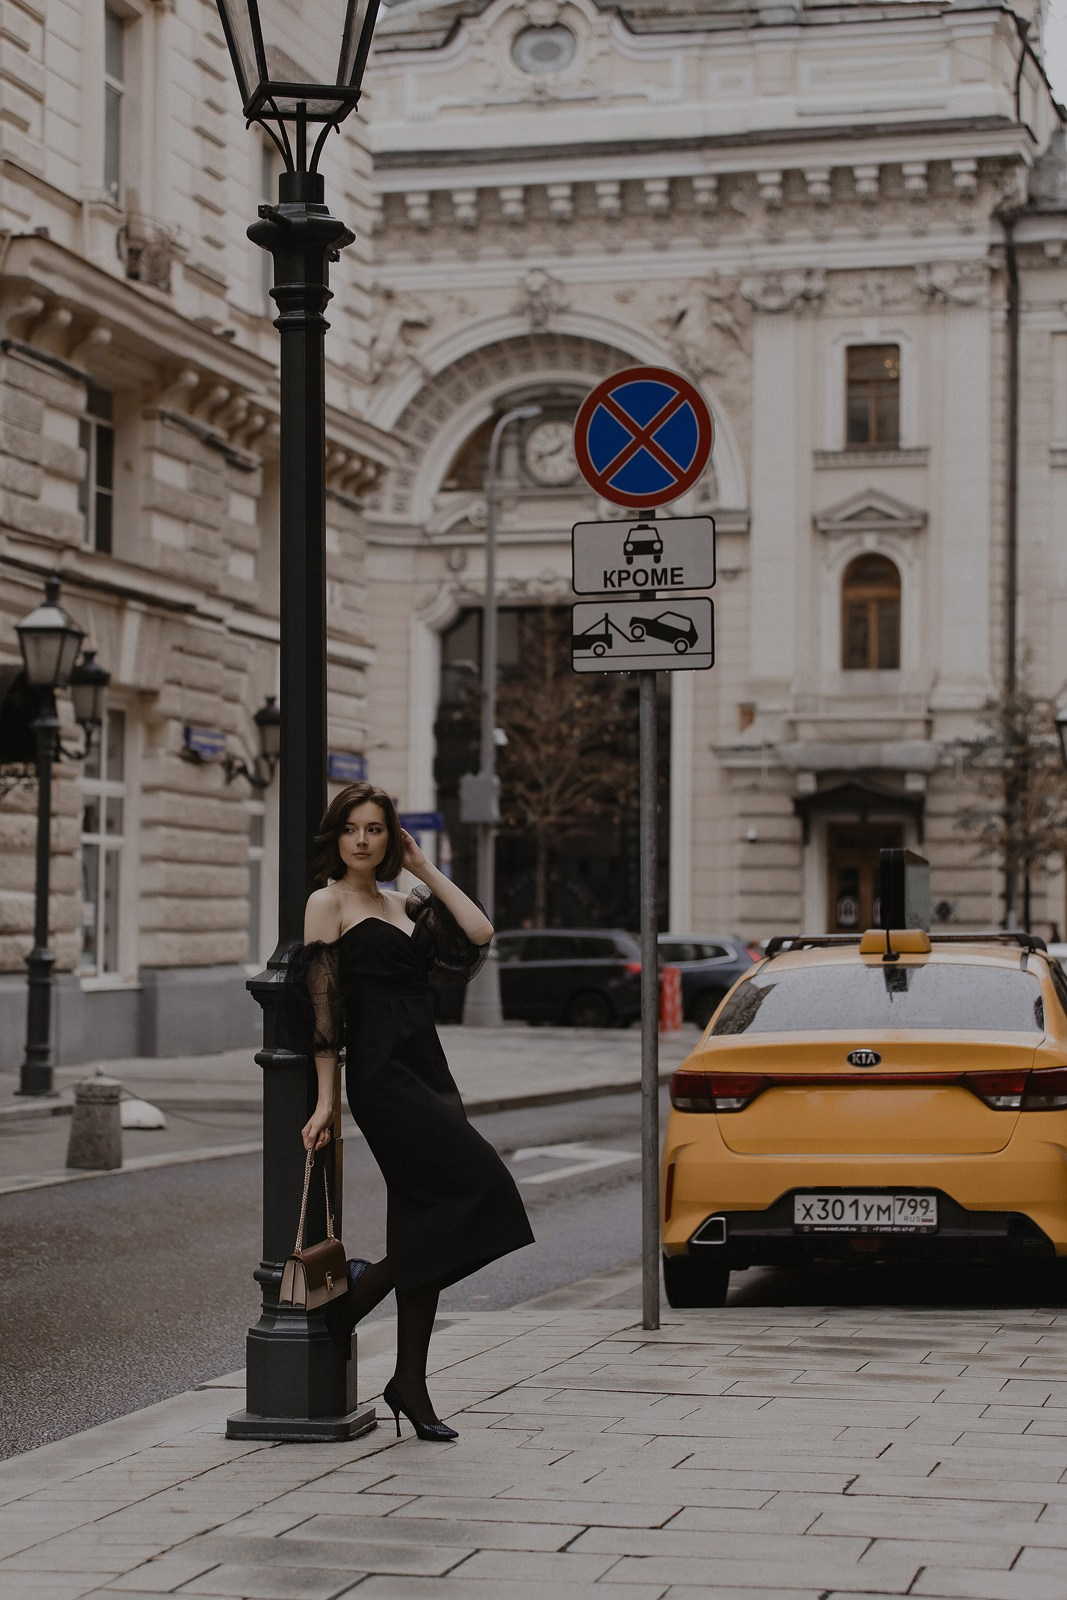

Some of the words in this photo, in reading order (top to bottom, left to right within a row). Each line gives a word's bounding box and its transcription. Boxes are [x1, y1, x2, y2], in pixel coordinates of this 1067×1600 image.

[603, 567, 684, 588] КРОМЕ
[852, 1053, 876, 1064] KIA
[895, 1197, 930, 1215] 799
